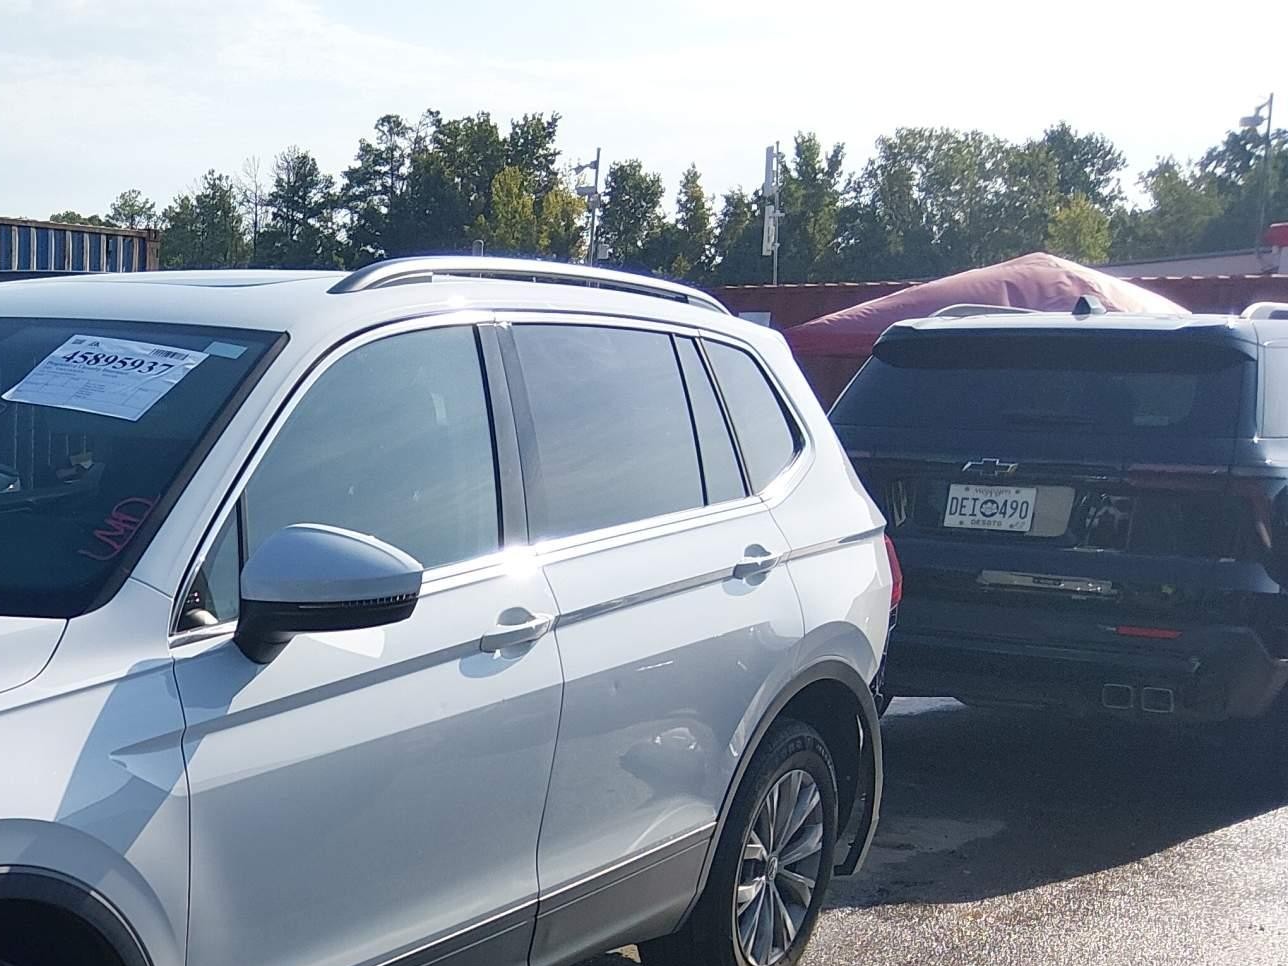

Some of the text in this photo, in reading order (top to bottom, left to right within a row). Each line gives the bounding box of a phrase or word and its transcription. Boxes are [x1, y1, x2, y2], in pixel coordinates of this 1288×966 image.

[62, 350, 175, 376] 45895937
[948, 496, 1030, 520] DEI 490
